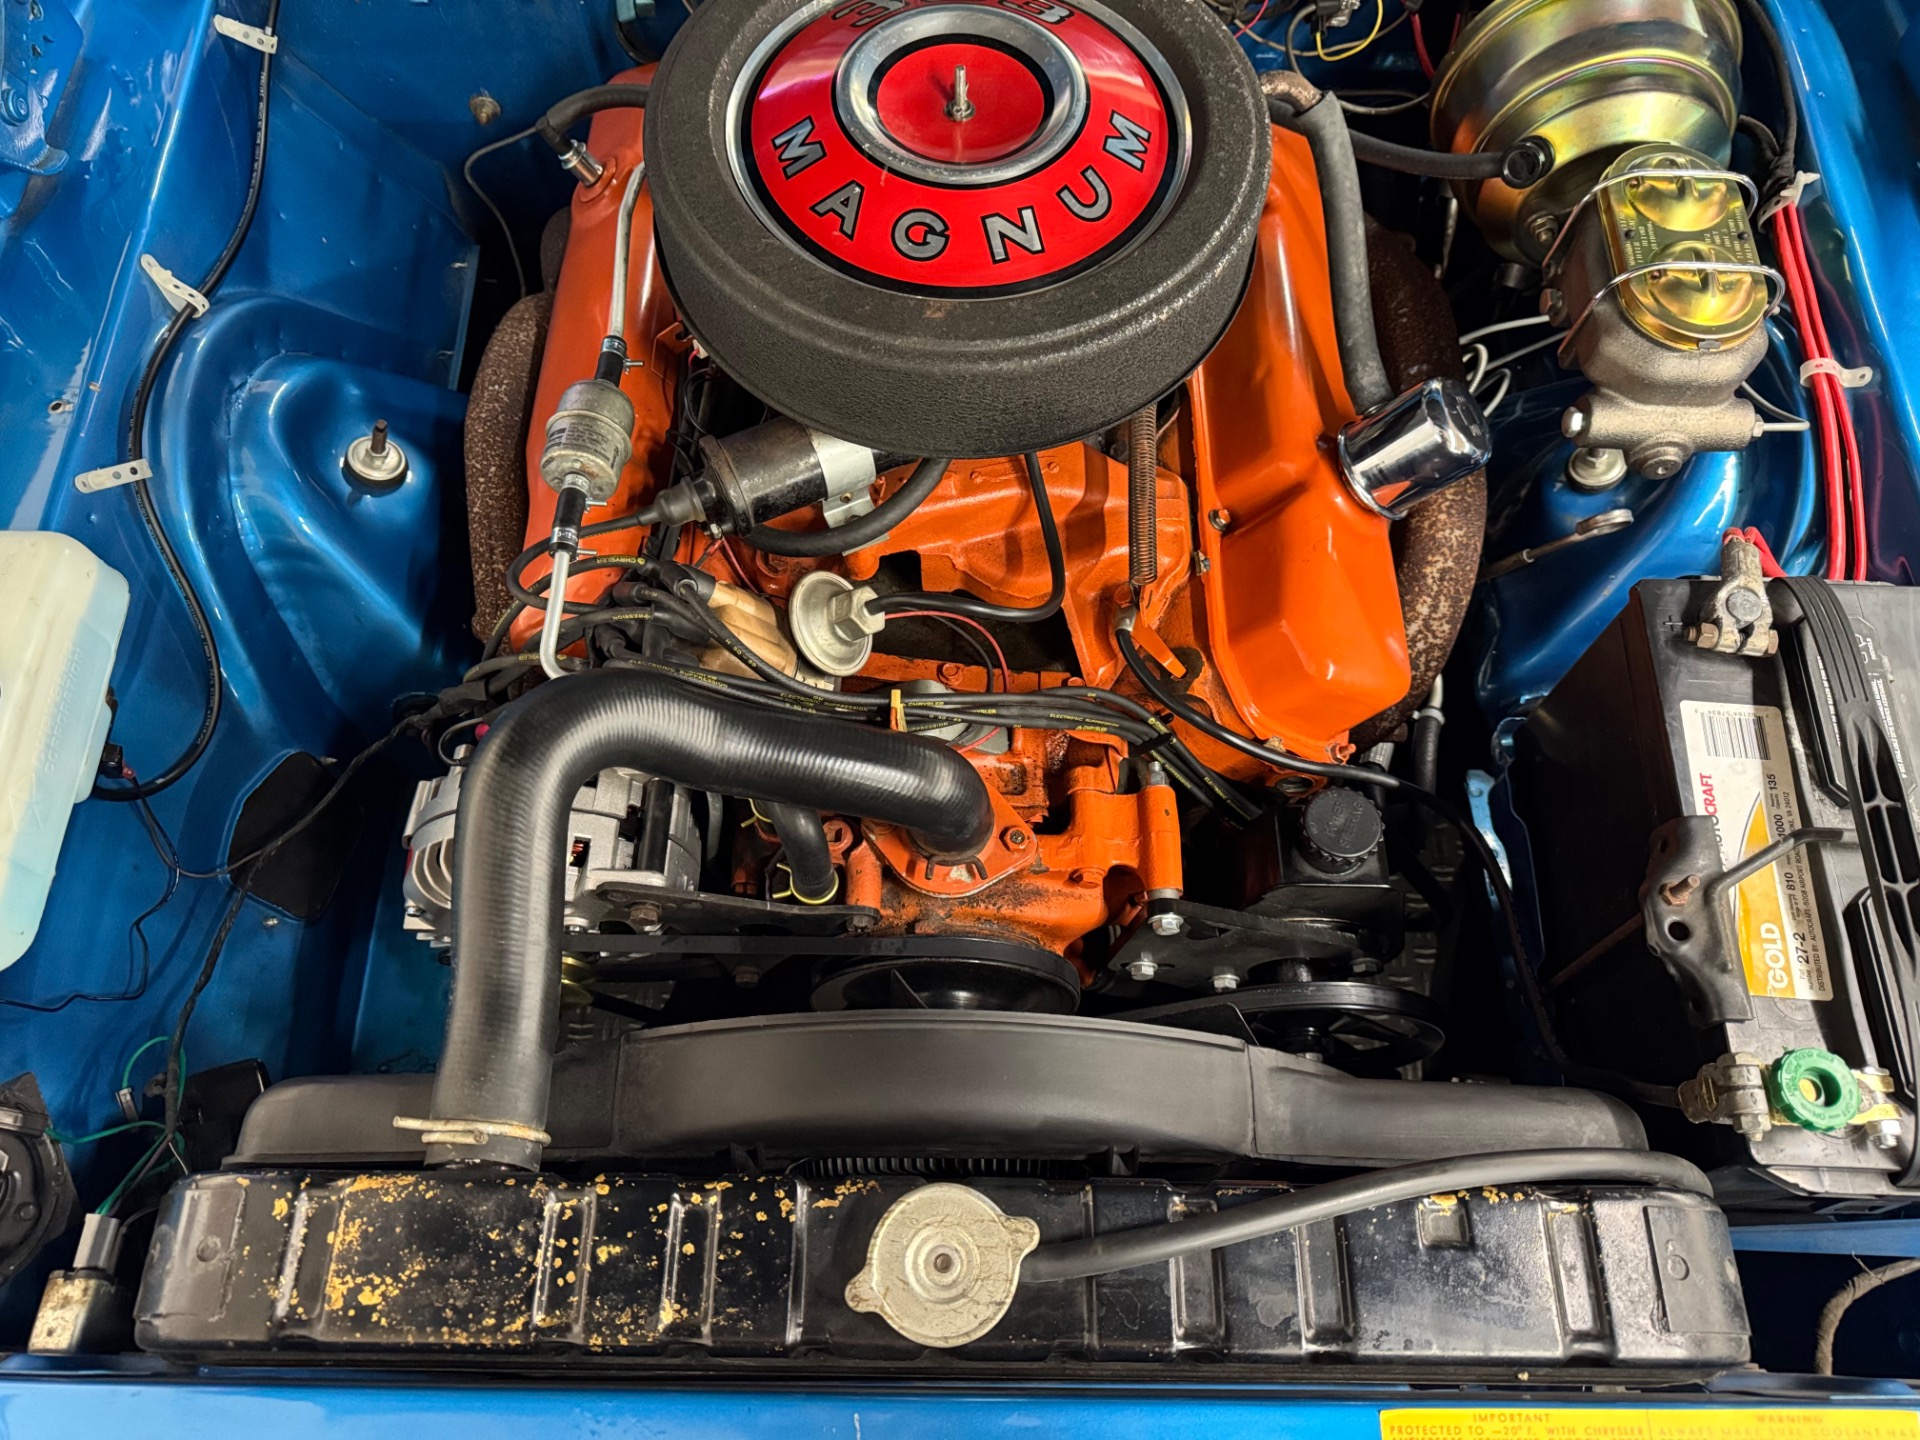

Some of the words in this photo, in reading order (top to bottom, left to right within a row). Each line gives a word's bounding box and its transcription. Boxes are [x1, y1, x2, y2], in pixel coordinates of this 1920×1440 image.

[831, 0, 1074, 28] 33
[771, 110, 1152, 265] MAGNUM
[780, 692, 820, 704] ELECTRONIC
[44, 647, 84, 772] CORPORATION
[1766, 773, 1777, 790] 135
[1782, 791, 1791, 808] 24012
[1323, 800, 1343, 836] POWER
[1773, 814, 1786, 836] 1000
[1783, 872, 1795, 889] 810
[1795, 865, 1805, 888] AIRPORT
[1760, 922, 1789, 989] GOLD
[1792, 932, 1809, 963] 27-2
[1812, 953, 1825, 991] DISTRIBUTED
[1473, 1413, 1550, 1423] IMPORTANT
[1755, 1415, 1823, 1424] WARNING
[1389, 1426, 1461, 1435] PROTECTED
[1467, 1426, 1484, 1435] TO
[1546, 1426, 1576, 1436] WITH
[1584, 1426, 1643, 1436] CHRYSLER
[1659, 1427, 1713, 1437] ALWAYS
[1811, 1427, 1880, 1437] COOLANT
